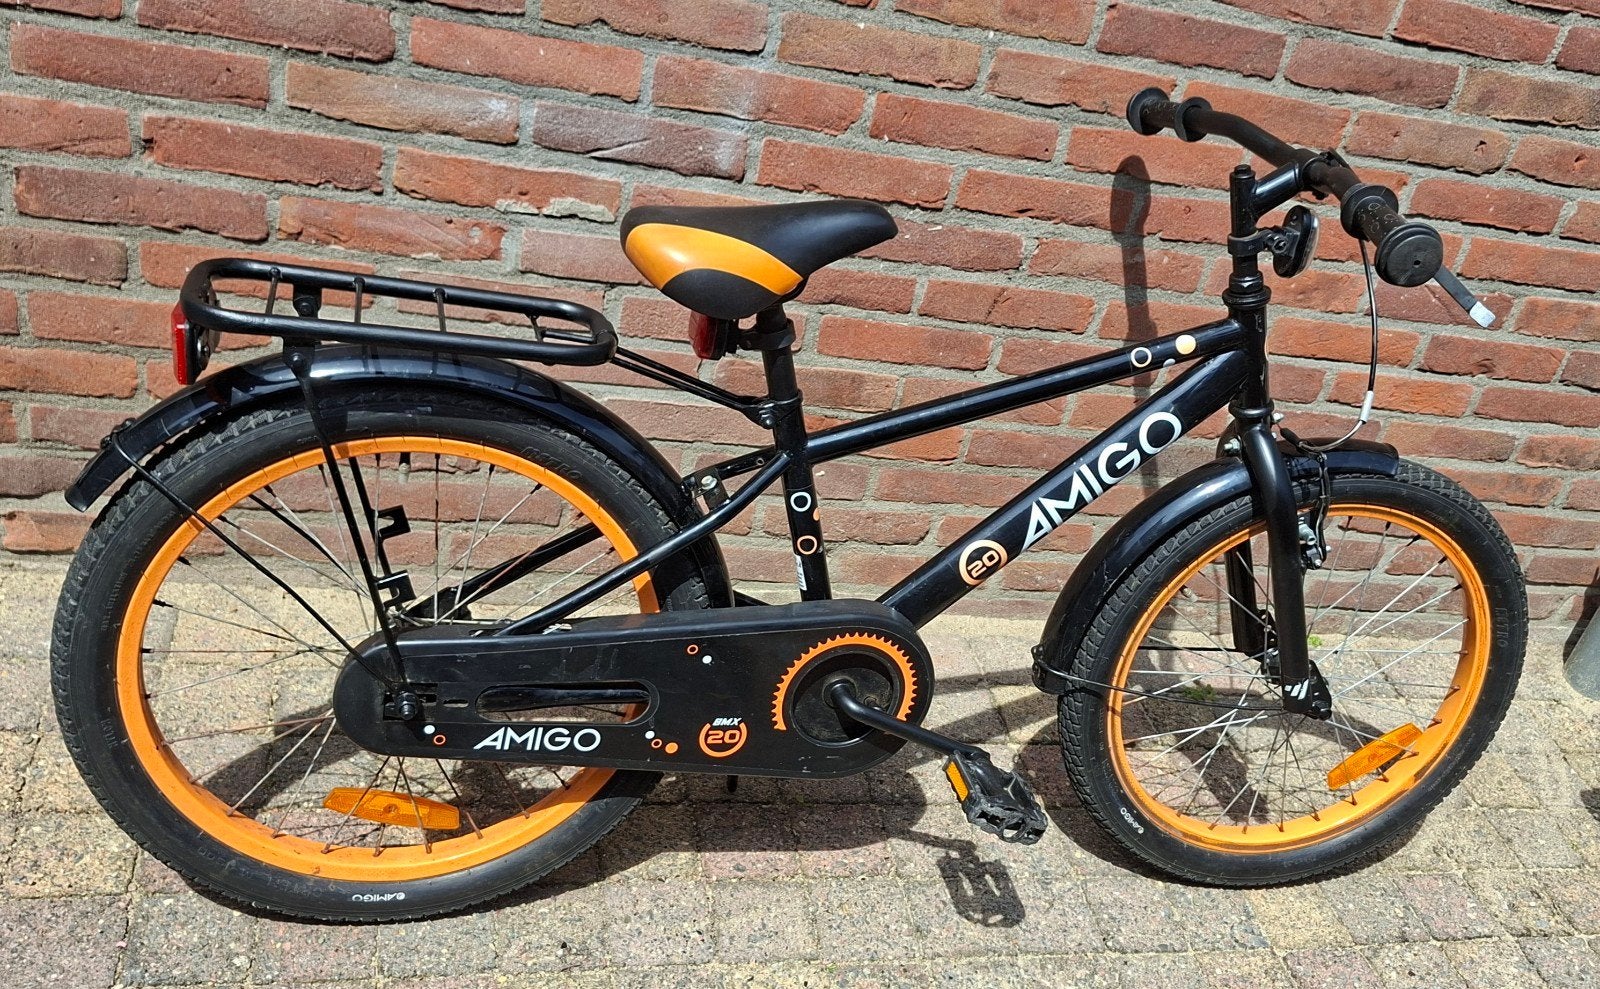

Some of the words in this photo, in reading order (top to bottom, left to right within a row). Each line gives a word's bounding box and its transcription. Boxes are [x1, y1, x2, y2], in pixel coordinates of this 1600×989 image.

[1020, 411, 1182, 552] AMIGO
[967, 549, 1000, 578] 20
[712, 717, 742, 727] BMX
[473, 726, 602, 752] AMIGO
[706, 729, 741, 744] 20
[352, 892, 397, 903] AMIGO
